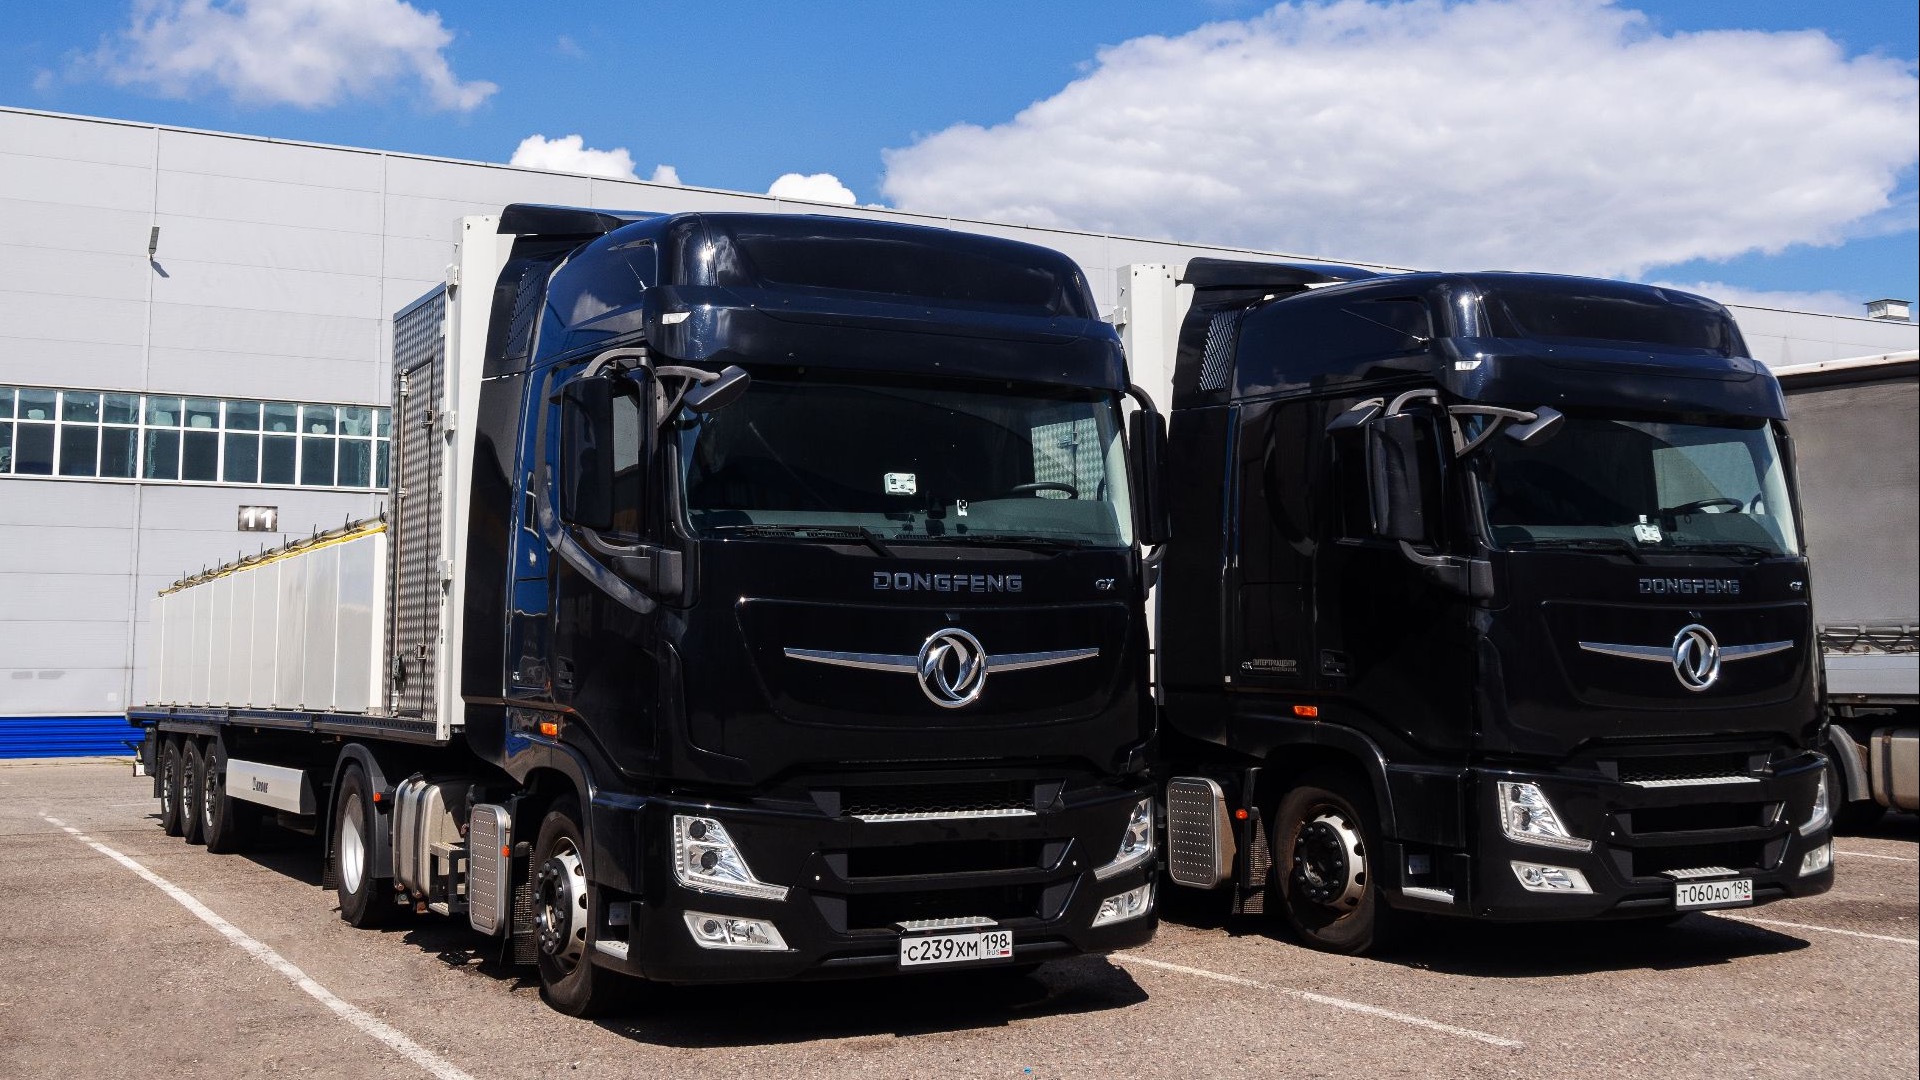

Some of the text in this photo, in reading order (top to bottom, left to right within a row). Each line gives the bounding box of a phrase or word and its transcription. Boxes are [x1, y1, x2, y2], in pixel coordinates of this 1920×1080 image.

[243, 509, 273, 529] 11
[873, 571, 1023, 593] DONGFENG
[1095, 578, 1115, 591] GX
[1639, 578, 1740, 594] DONGFENG
[1731, 880, 1749, 895] 198
[981, 933, 1008, 950] 198
